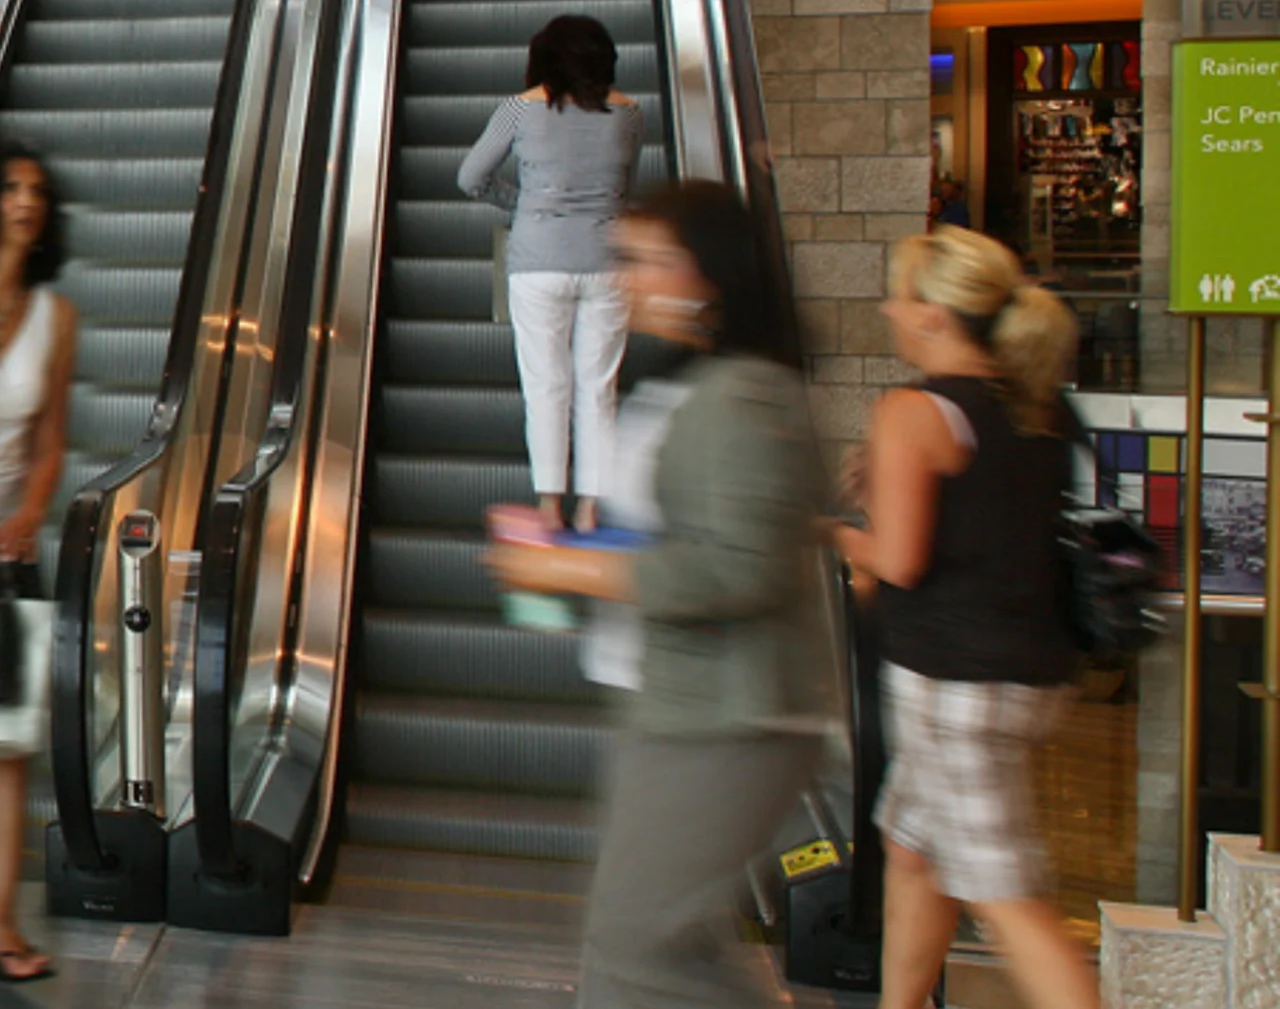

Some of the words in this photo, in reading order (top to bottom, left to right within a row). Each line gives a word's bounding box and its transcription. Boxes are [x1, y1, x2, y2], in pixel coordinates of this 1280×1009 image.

[1199, 56, 1280, 77] Rainier
[1200, 105, 1231, 125] JC
[1200, 133, 1264, 154] Sears
